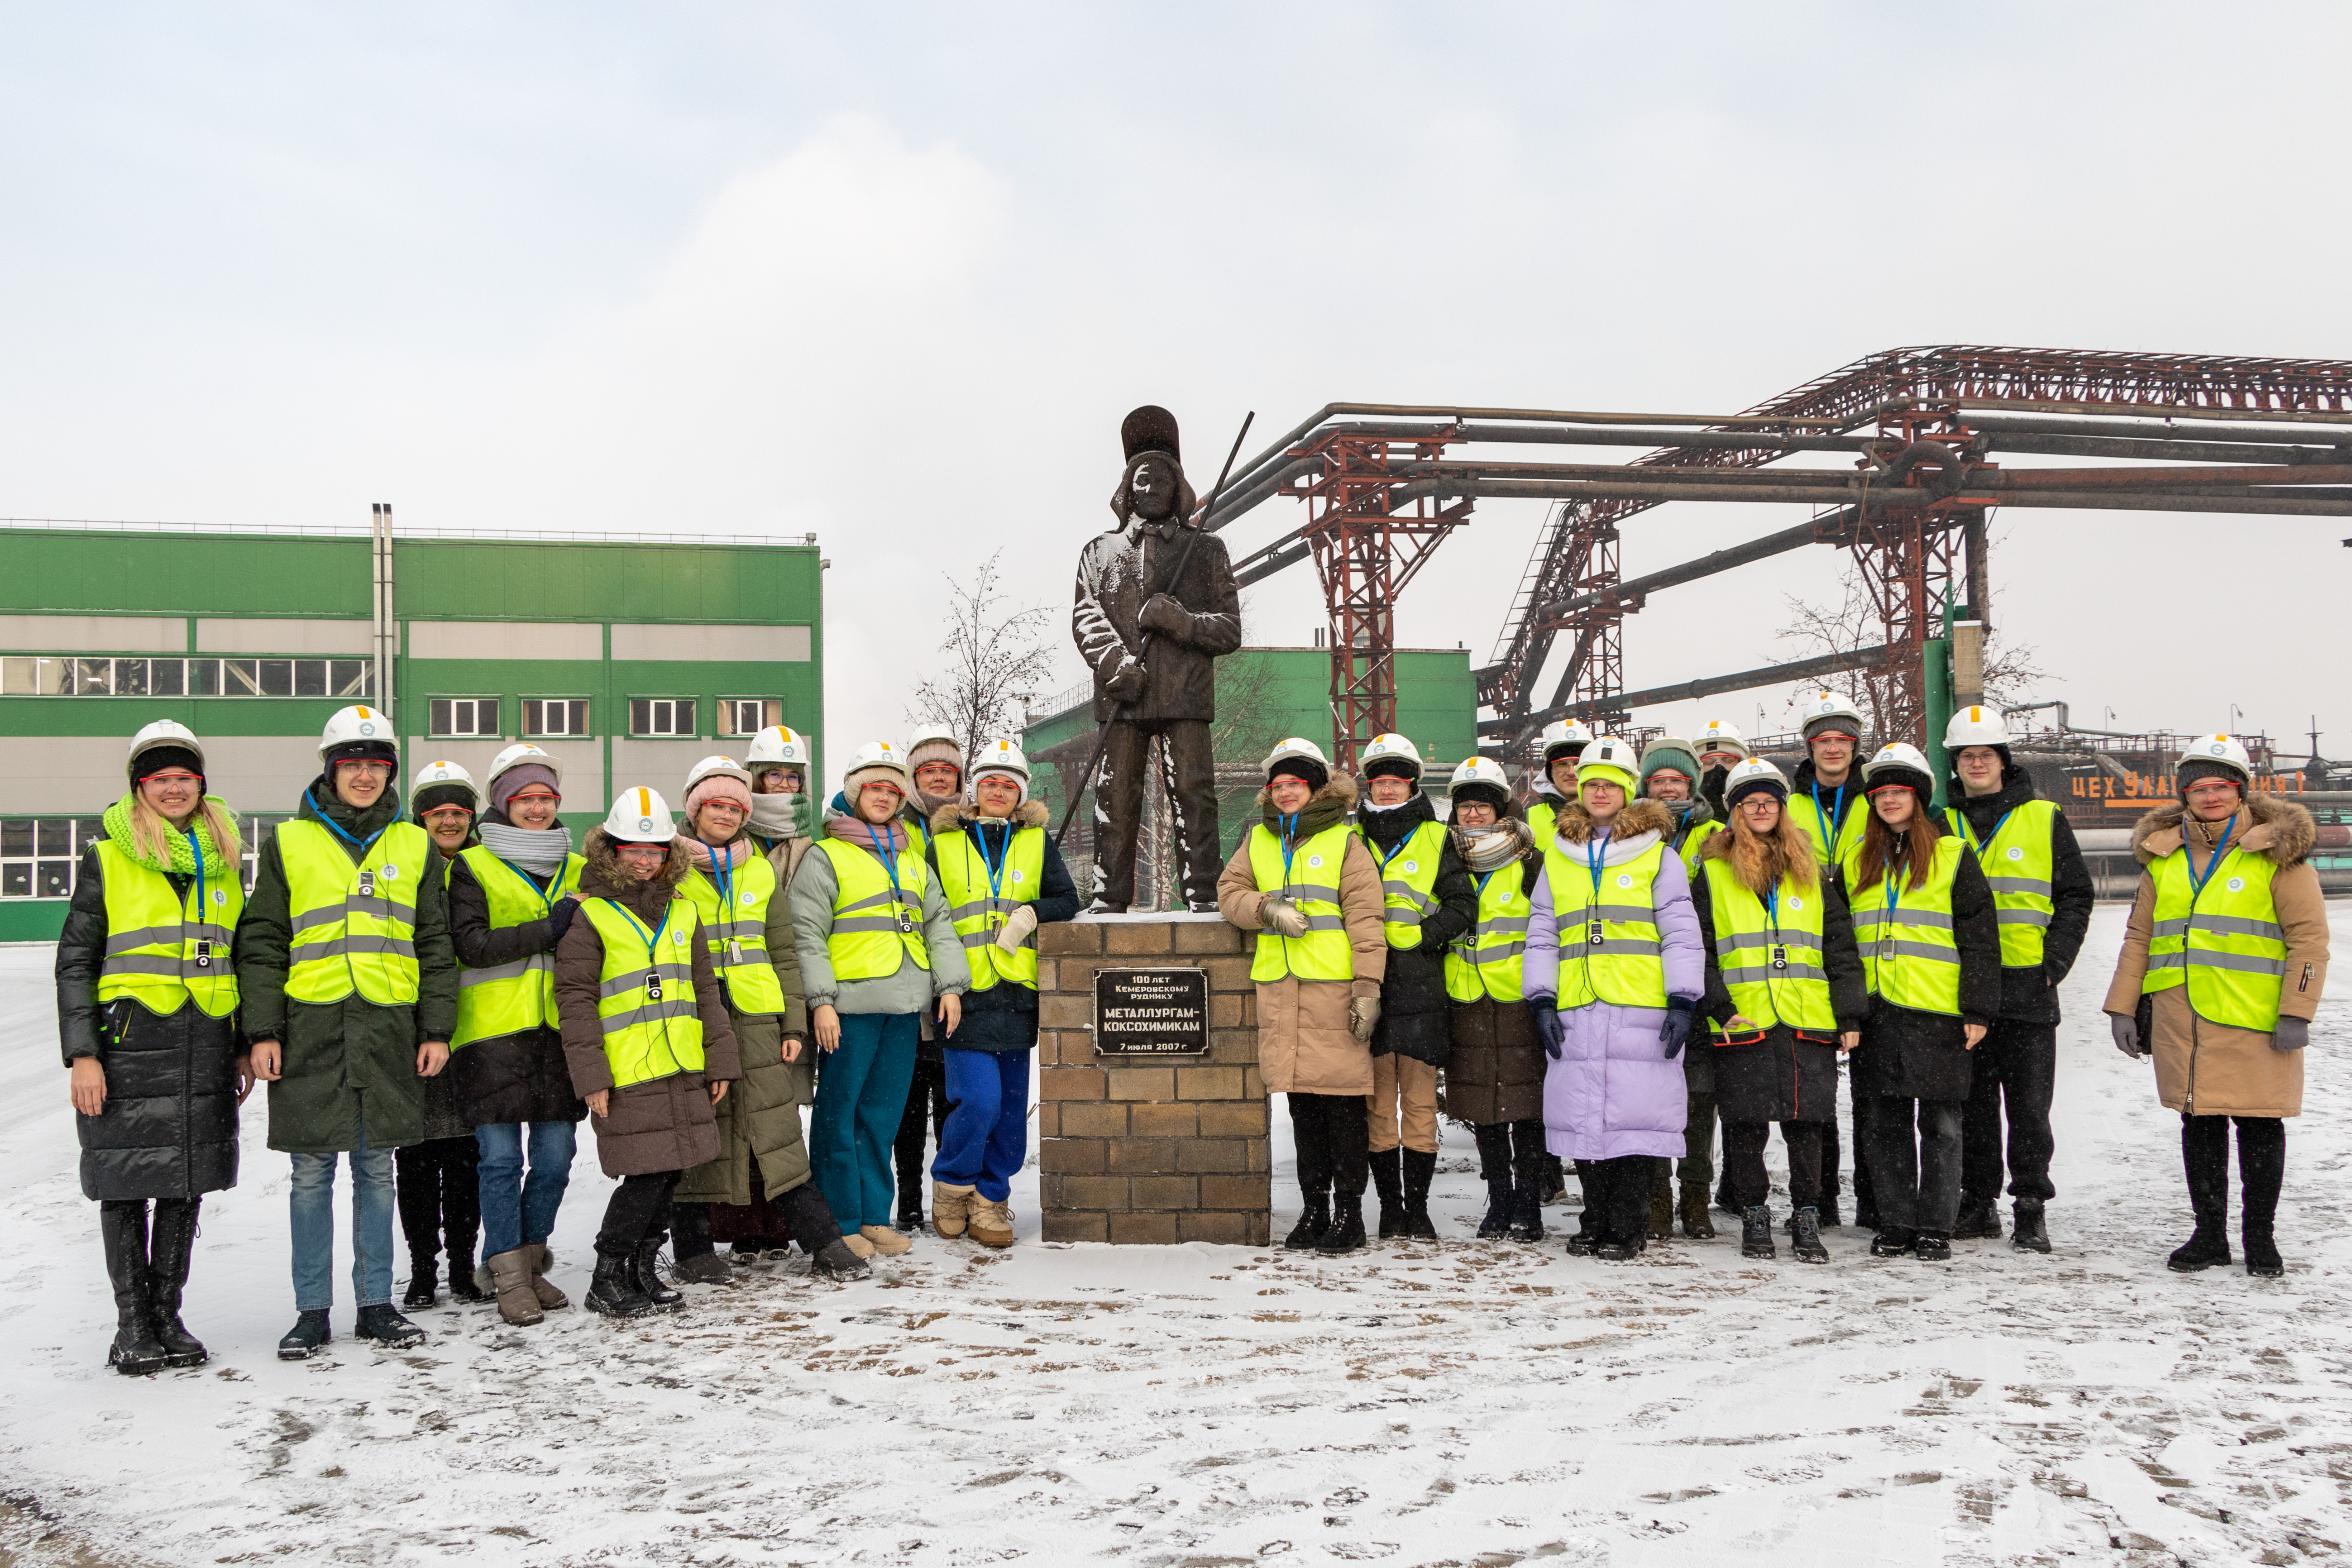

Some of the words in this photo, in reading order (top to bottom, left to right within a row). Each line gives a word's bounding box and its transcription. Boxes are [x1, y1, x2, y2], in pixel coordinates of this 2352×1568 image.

[2072, 777, 2115, 798] ЦЕХ
[2295, 770, 2304, 796] 1
[1105, 1008, 1200, 1018] МЕТАЛЛУРГАМ-
[1104, 1021, 1200, 1032] КОКСОХИМИКАМ
